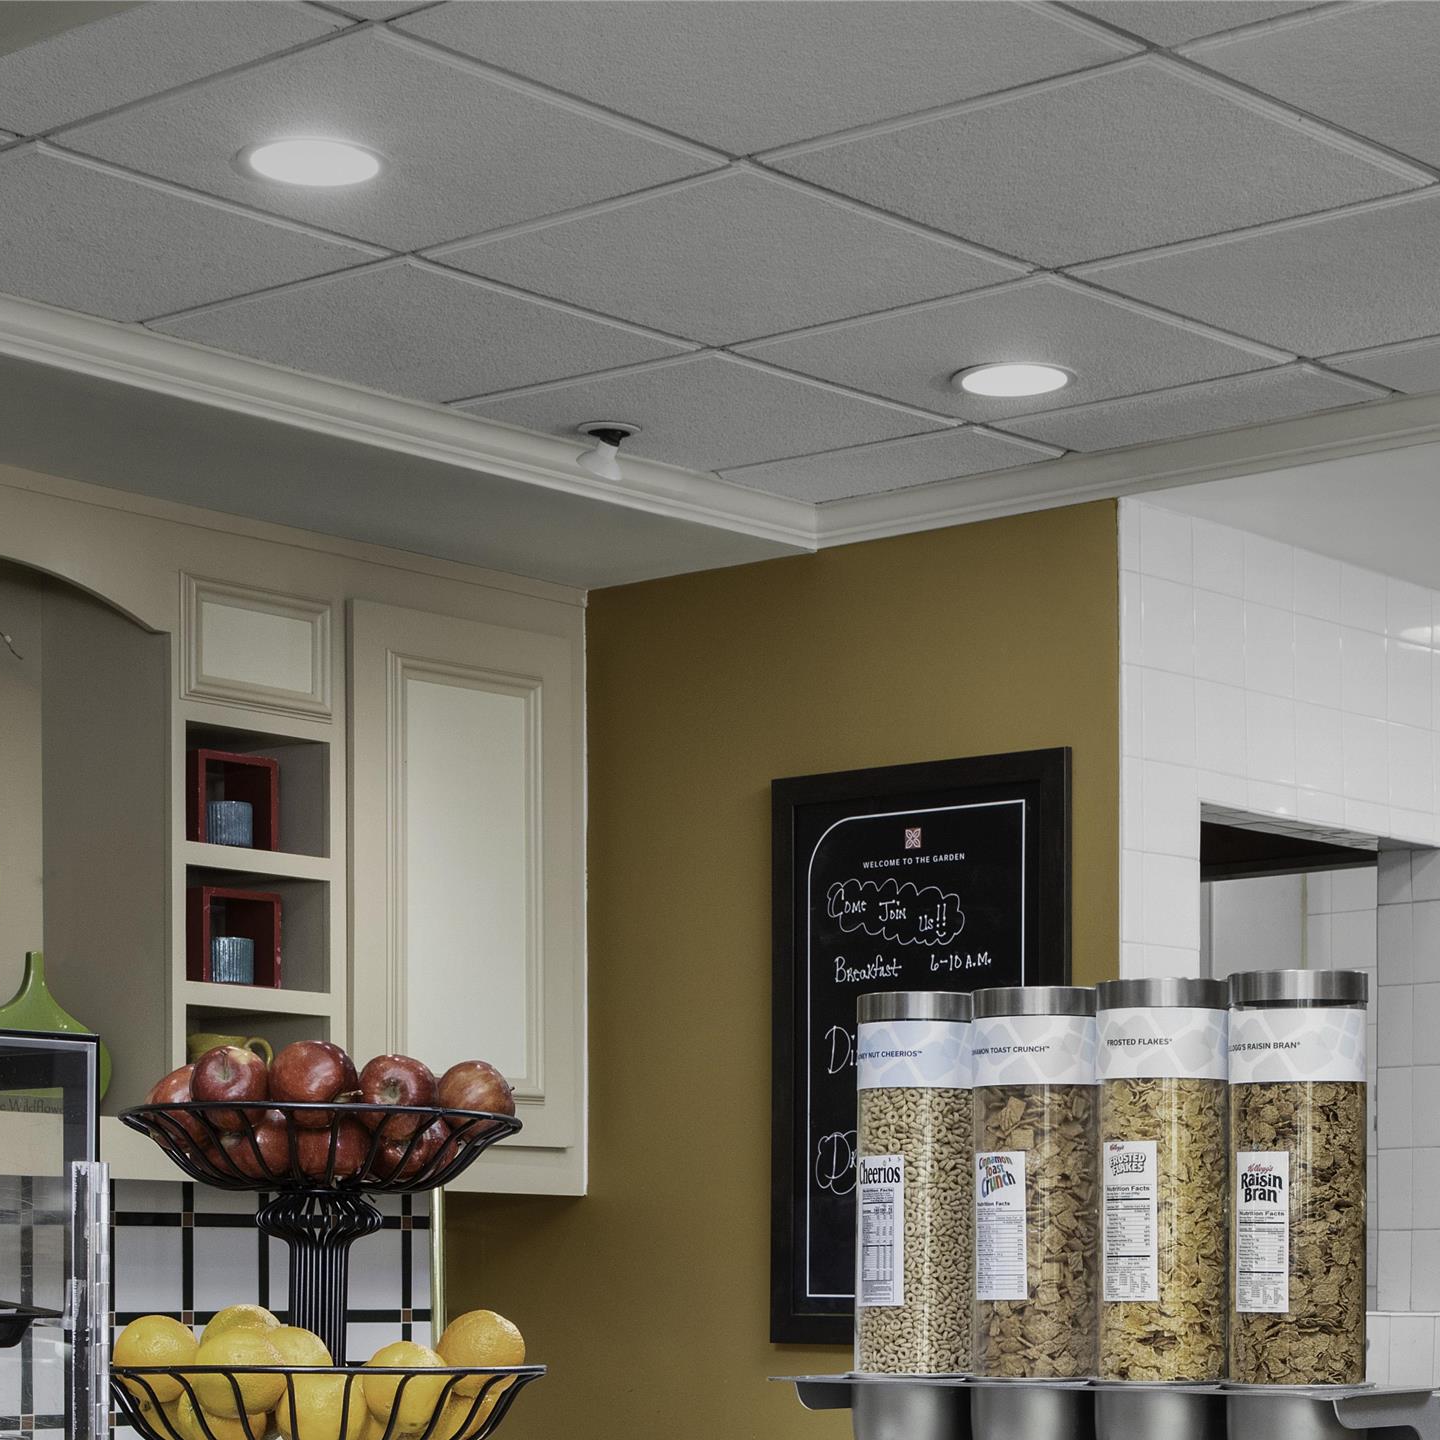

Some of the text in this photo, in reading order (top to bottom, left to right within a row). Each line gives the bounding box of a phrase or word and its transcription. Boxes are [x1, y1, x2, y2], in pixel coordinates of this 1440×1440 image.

[862, 852, 966, 869] WELCOME TO THE GARDEN
[834, 951, 992, 983] Breakfast 6-10 A.M.
[990, 1046, 1011, 1055] TOAST
[1106, 1038, 1137, 1047] FROSTED
[1246, 1042, 1271, 1051] RAISIN
[869, 1051, 880, 1059] NUT
[1109, 1152, 1146, 1167] FROSTED
[860, 1159, 901, 1185] Cheerios
[1110, 1162, 1145, 1176] FLAKES
[981, 1170, 1016, 1198] Crunch
[1241, 1172, 1283, 1190] Raisin
[1244, 1187, 1278, 1204] Bran
